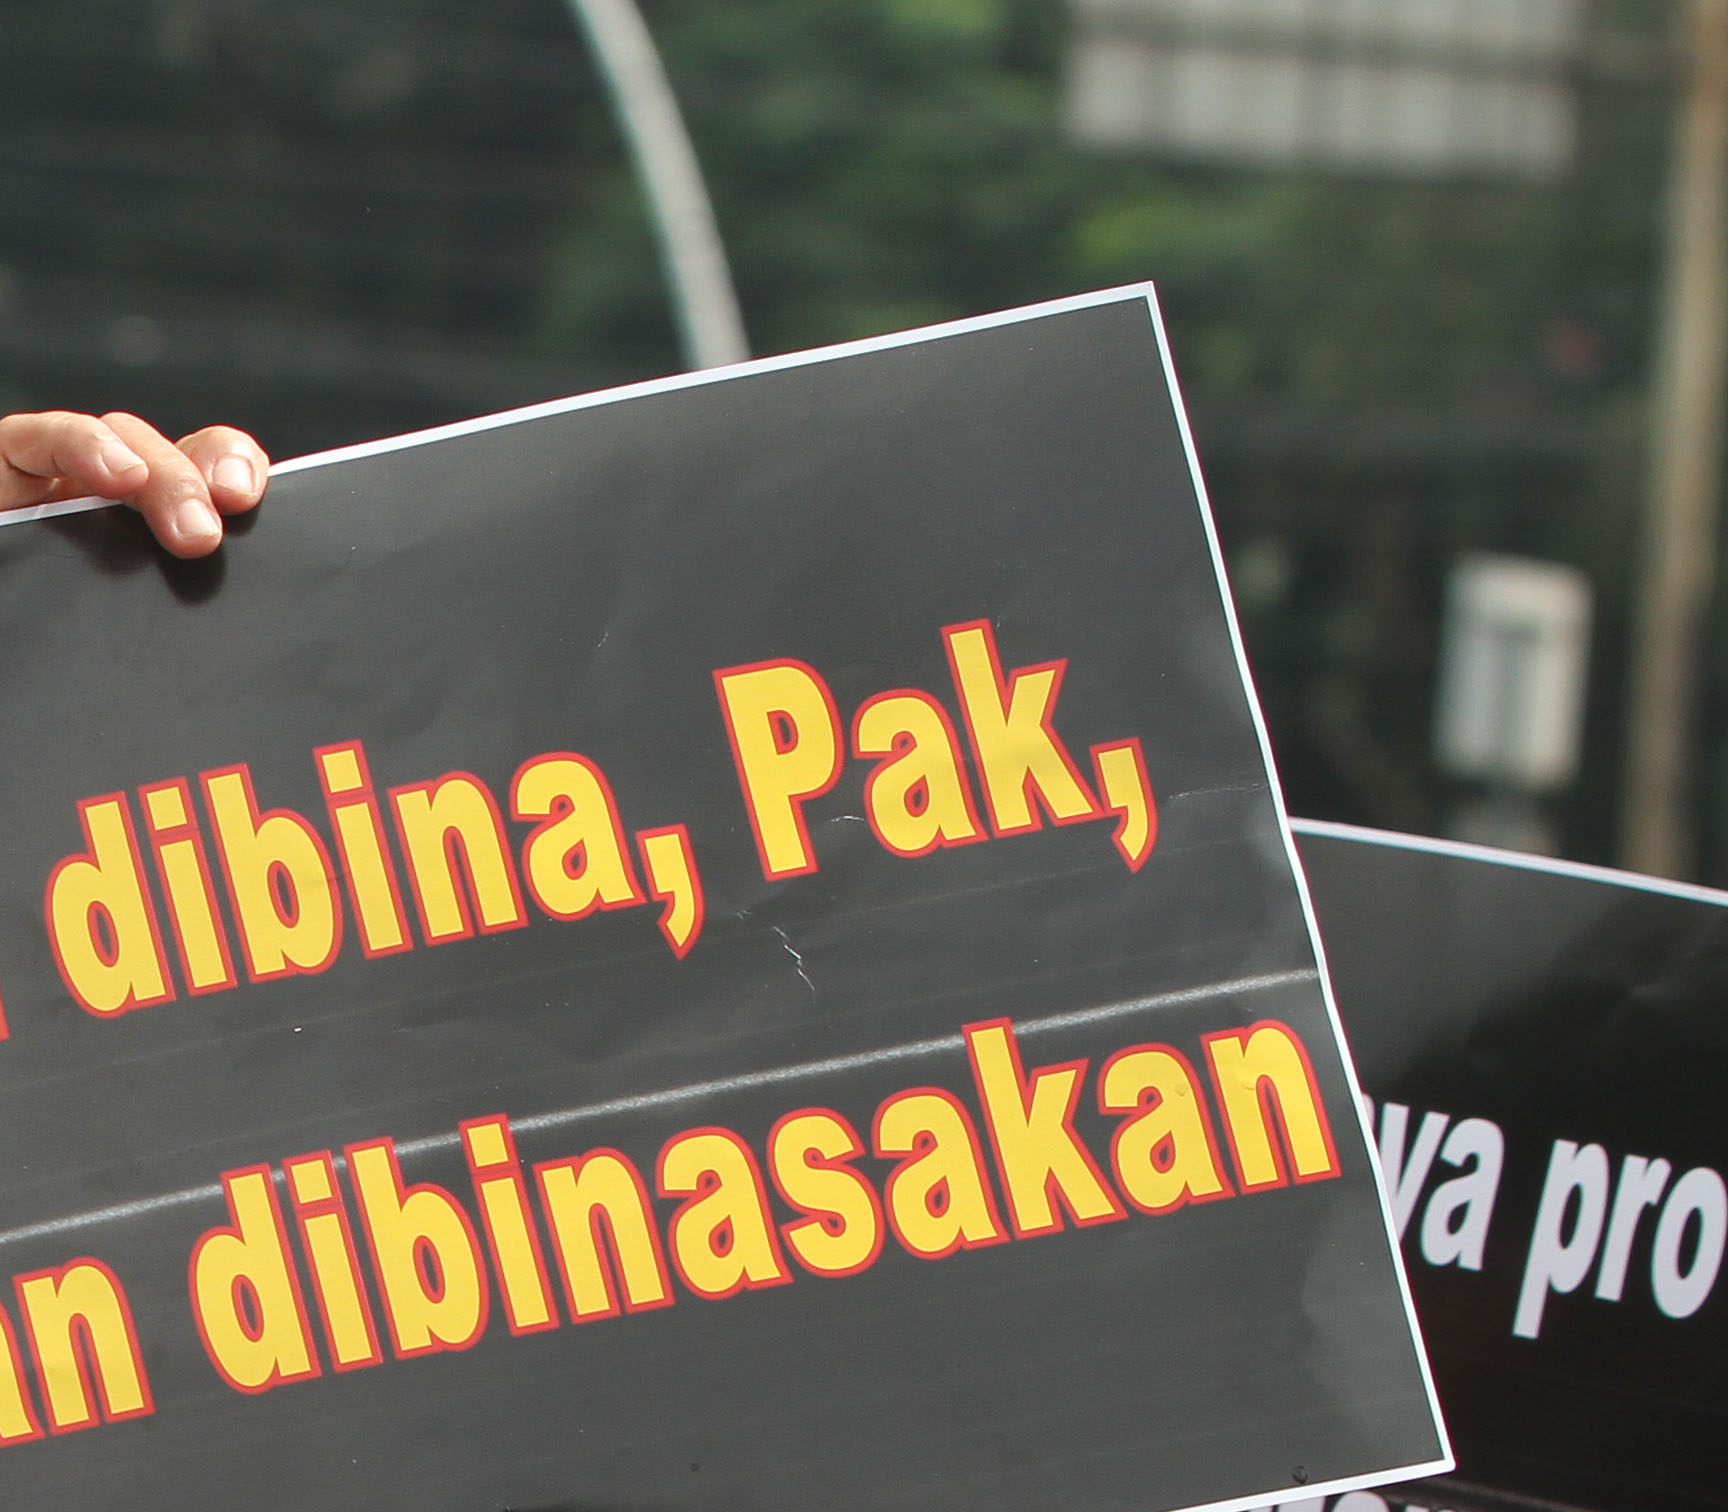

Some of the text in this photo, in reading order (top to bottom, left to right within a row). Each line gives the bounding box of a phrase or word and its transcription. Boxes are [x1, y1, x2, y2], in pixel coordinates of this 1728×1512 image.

[43, 738, 707, 1020] dibina,
[711, 617, 1159, 882] Pak,
[187, 1015, 1344, 1396] dibinasakan
[1513, 1138, 1728, 1339] pro
